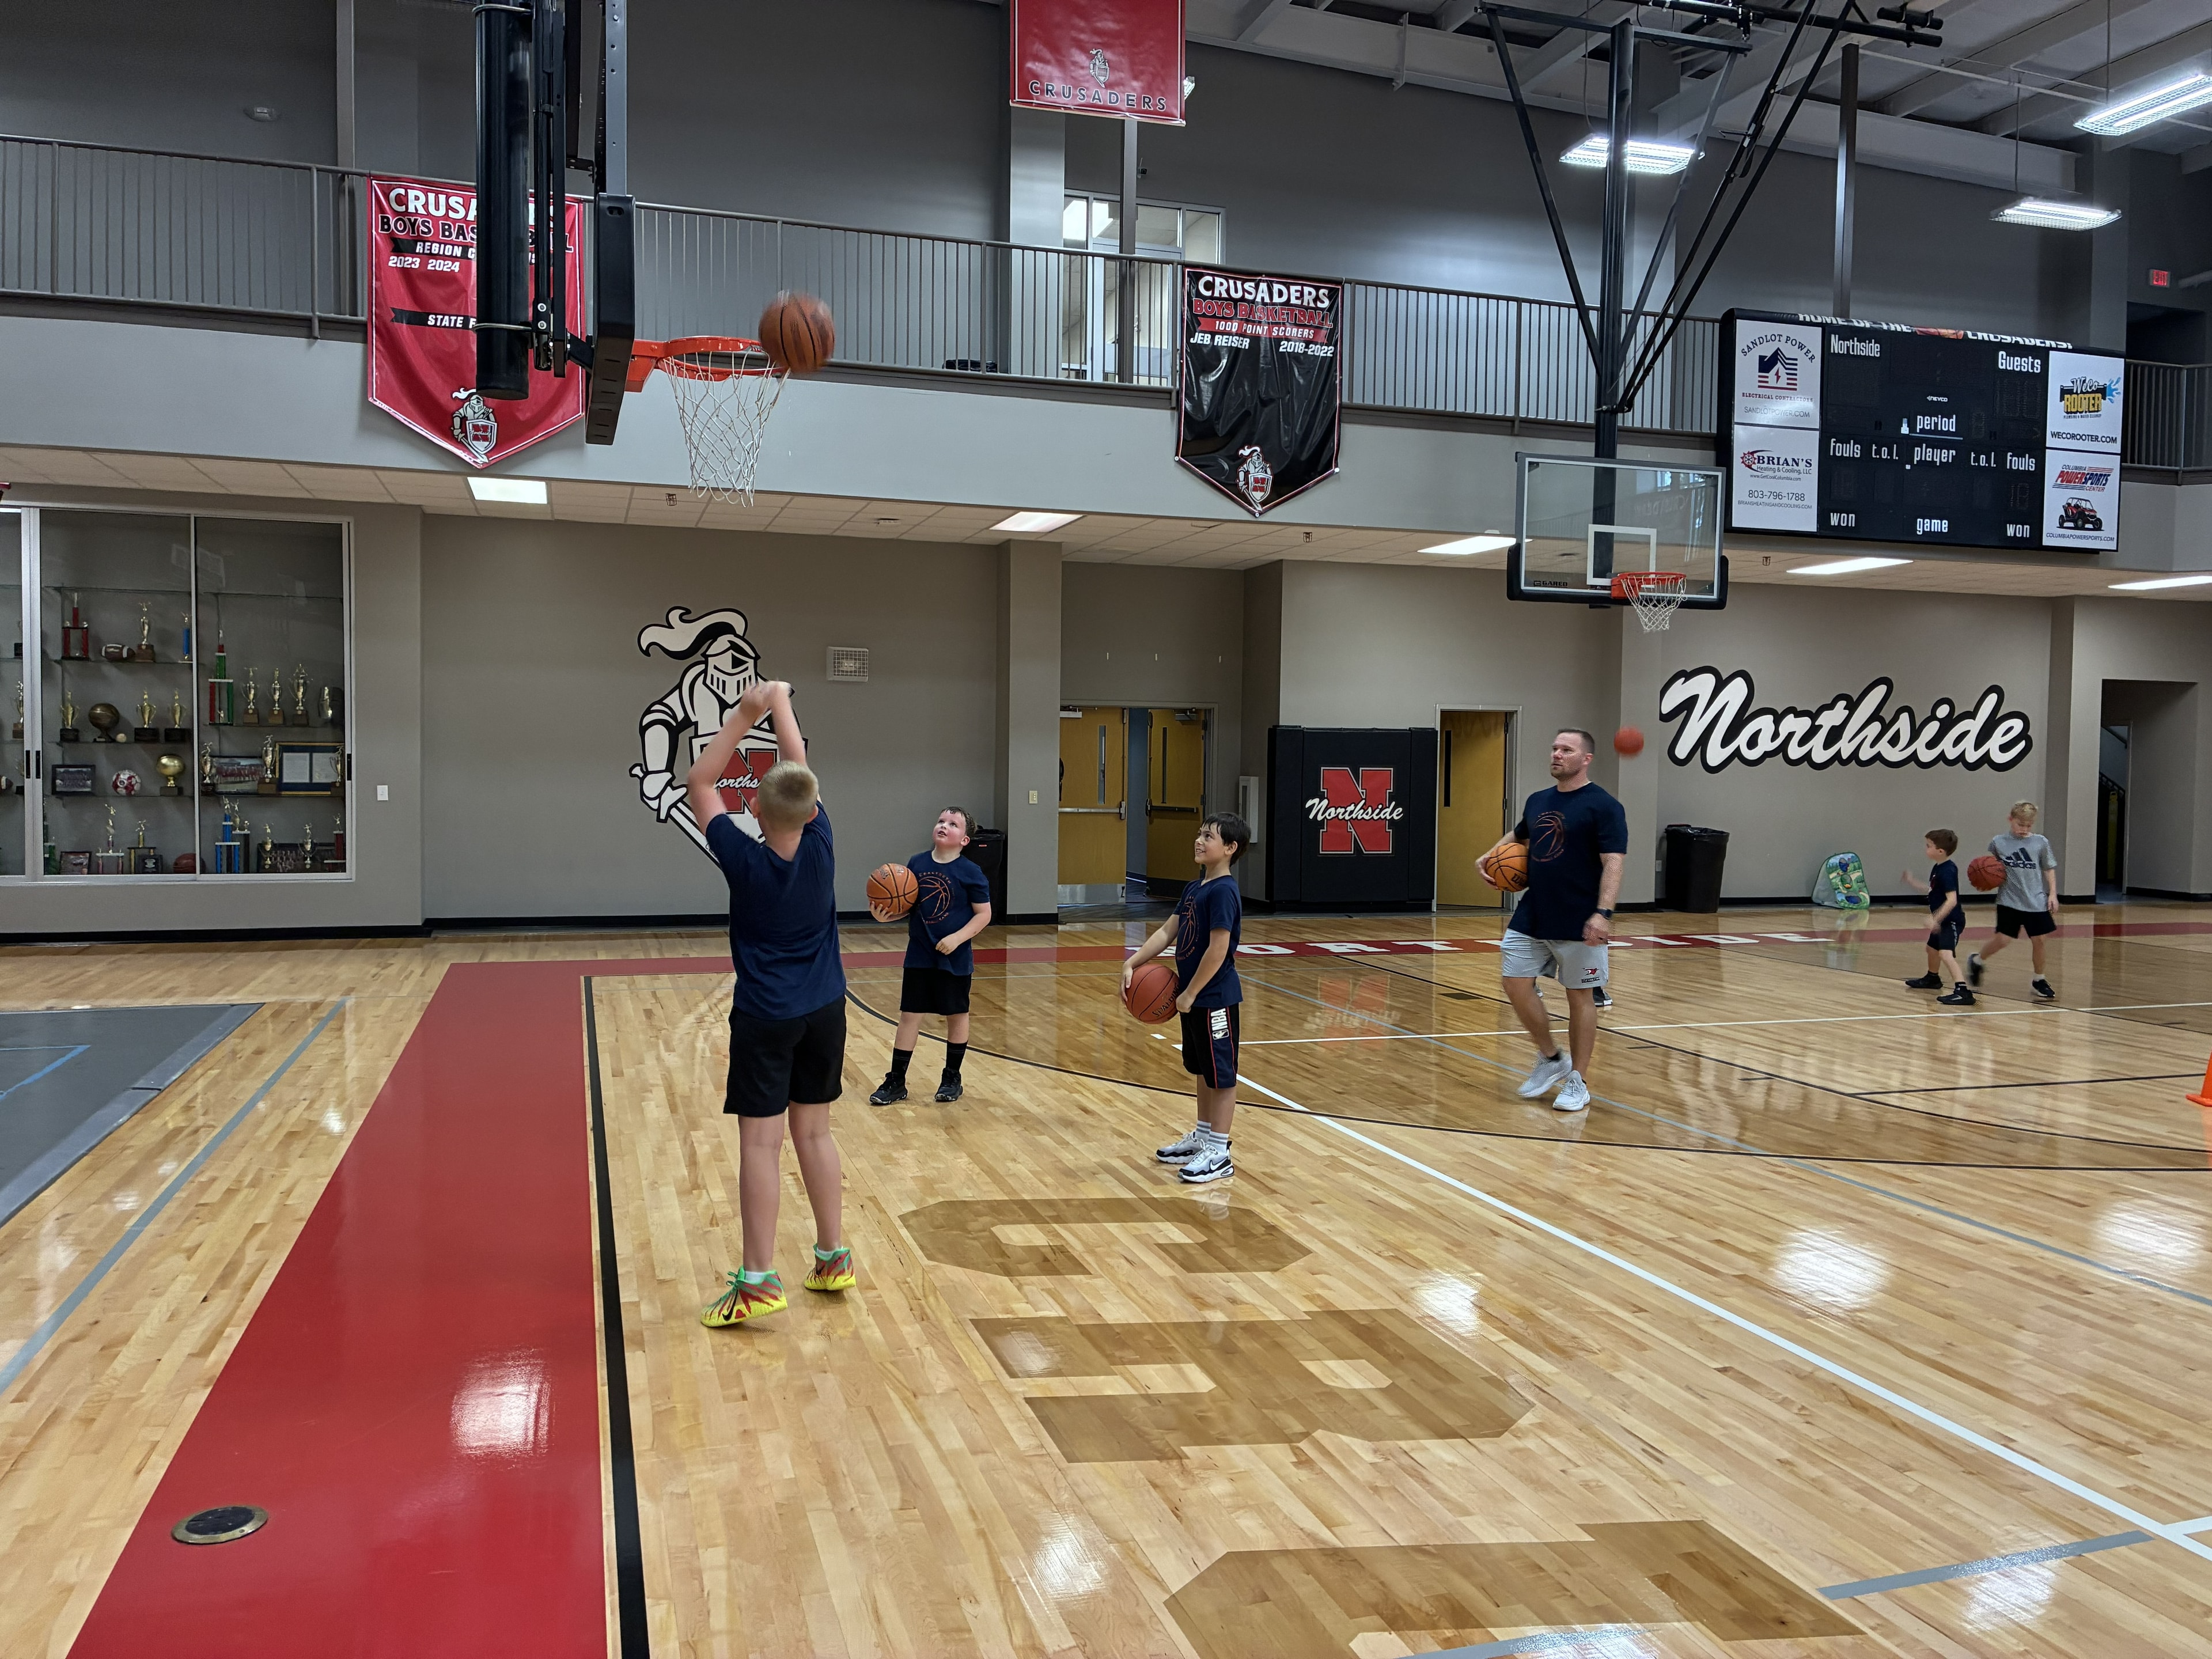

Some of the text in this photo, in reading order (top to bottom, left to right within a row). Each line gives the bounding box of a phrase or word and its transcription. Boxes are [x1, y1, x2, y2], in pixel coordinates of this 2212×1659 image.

[1029, 80, 1166, 111] CRUSADERS
[379, 214, 433, 237] BOYS
[416, 242, 462, 257] REGION
[388, 256, 460, 272] 2023 2024
[1198, 276, 1330, 308] CRUSADERS
[427, 314, 463, 327] STATE
[1193, 298, 1333, 328] BOYS BASKETBALL
[1215, 321, 1314, 339] 1000 POINT SCORERS
[1190, 332, 1335, 357] JEB REISER 2018-2022
[1741, 334, 1816, 363] SANDLOT POWER
[1831, 334, 1880, 357] Northside
[1998, 351, 2041, 373] Guests
[1744, 406, 1810, 418] SANDLOTPOWER.COM
[2064, 393, 2102, 413] ROOTER
[1916, 415, 1956, 433] period
[2051, 431, 2117, 444] WECOROOTER.COM
[1830, 438, 1861, 458] fouls
[1914, 444, 1956, 465] player
[1757, 455, 1812, 468] BRIAN'S
[2006, 452, 2036, 471] fouls
[2055, 471, 2111, 486] POWERSPORTS
[1748, 490, 1805, 501] 803-796-1788
[1830, 513, 1855, 527] won
[1916, 518, 1948, 535] game
[2007, 524, 2030, 537] won
[2046, 533, 2115, 541] COLUMBIAPOWERSPORTS.COM
[1660, 666, 2032, 774] Northside
[1305, 797, 1403, 821] Northside
[1320, 767, 1393, 854] N
[1152, 982, 1181, 1018] SPALDING
[1211, 1008, 1228, 1031] NBA
